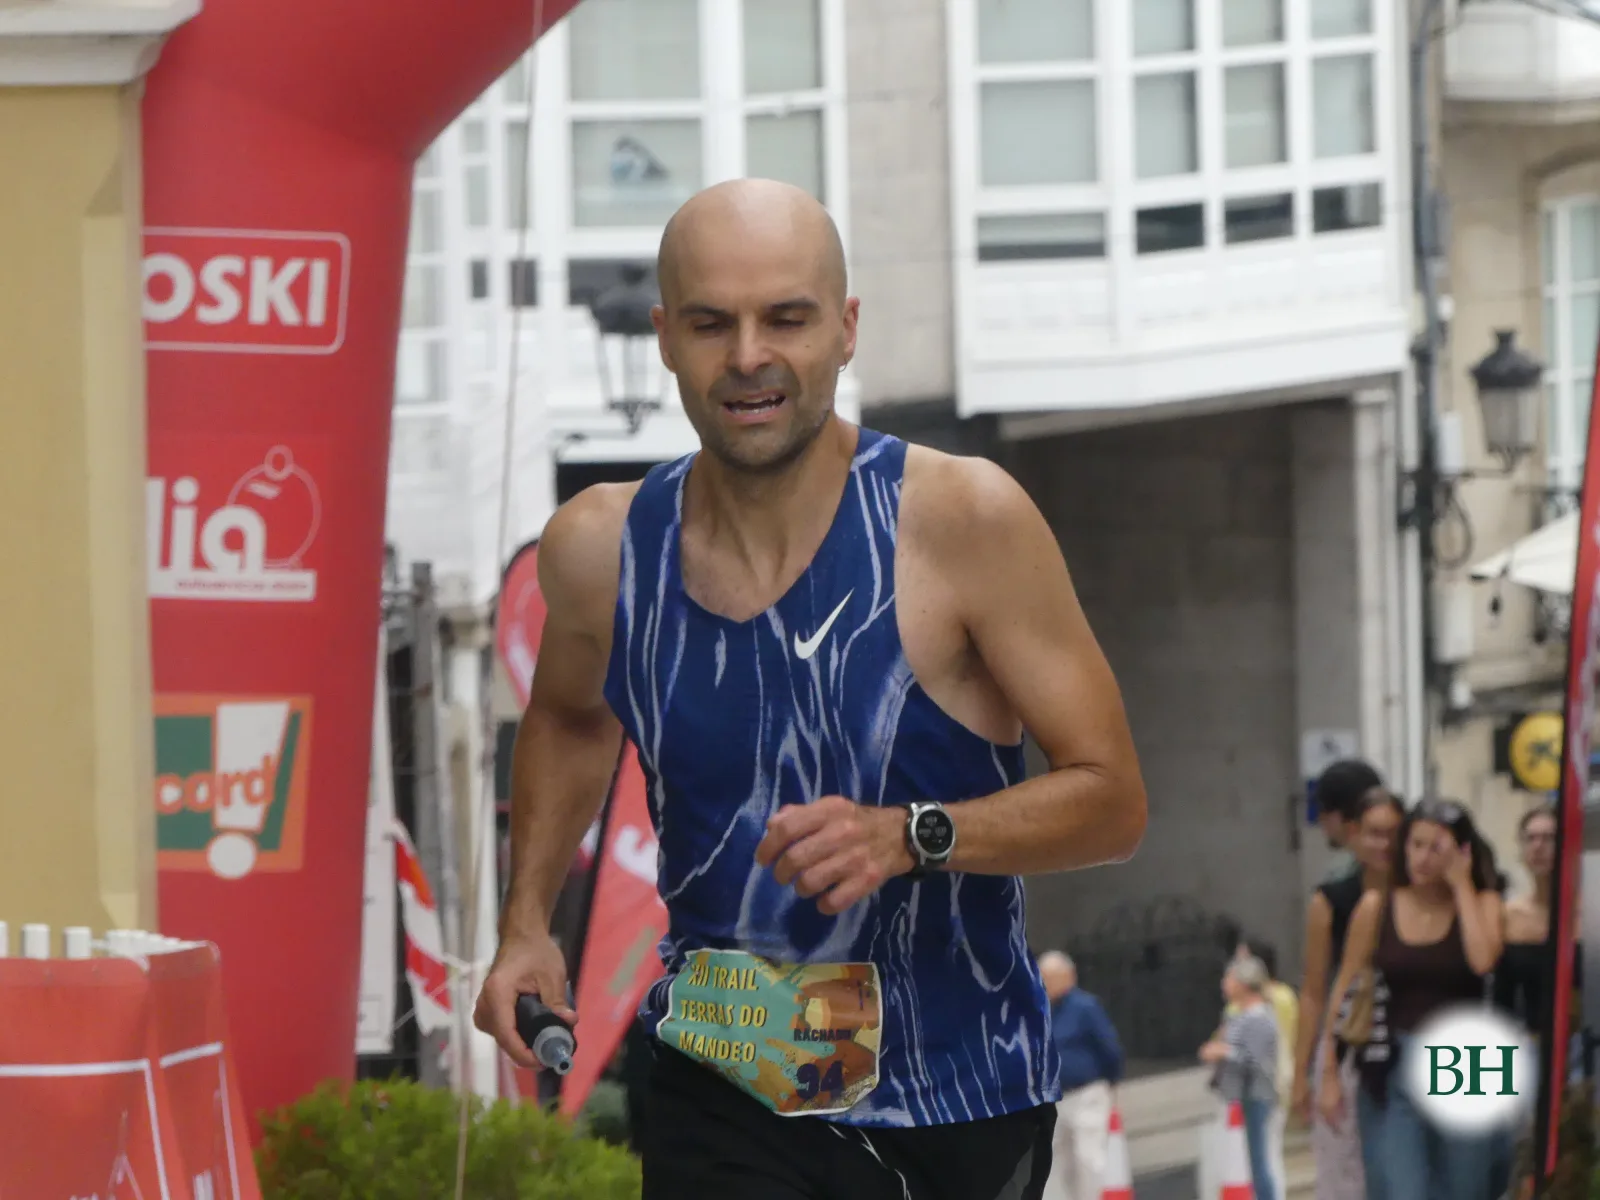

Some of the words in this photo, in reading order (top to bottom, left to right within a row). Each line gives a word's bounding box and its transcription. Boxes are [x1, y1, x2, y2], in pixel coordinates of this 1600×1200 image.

[712, 965, 759, 991] TRAIL
[680, 999, 733, 1026] TERRAS
[739, 1004, 767, 1028] DO
[679, 1031, 756, 1063] MANDEO
